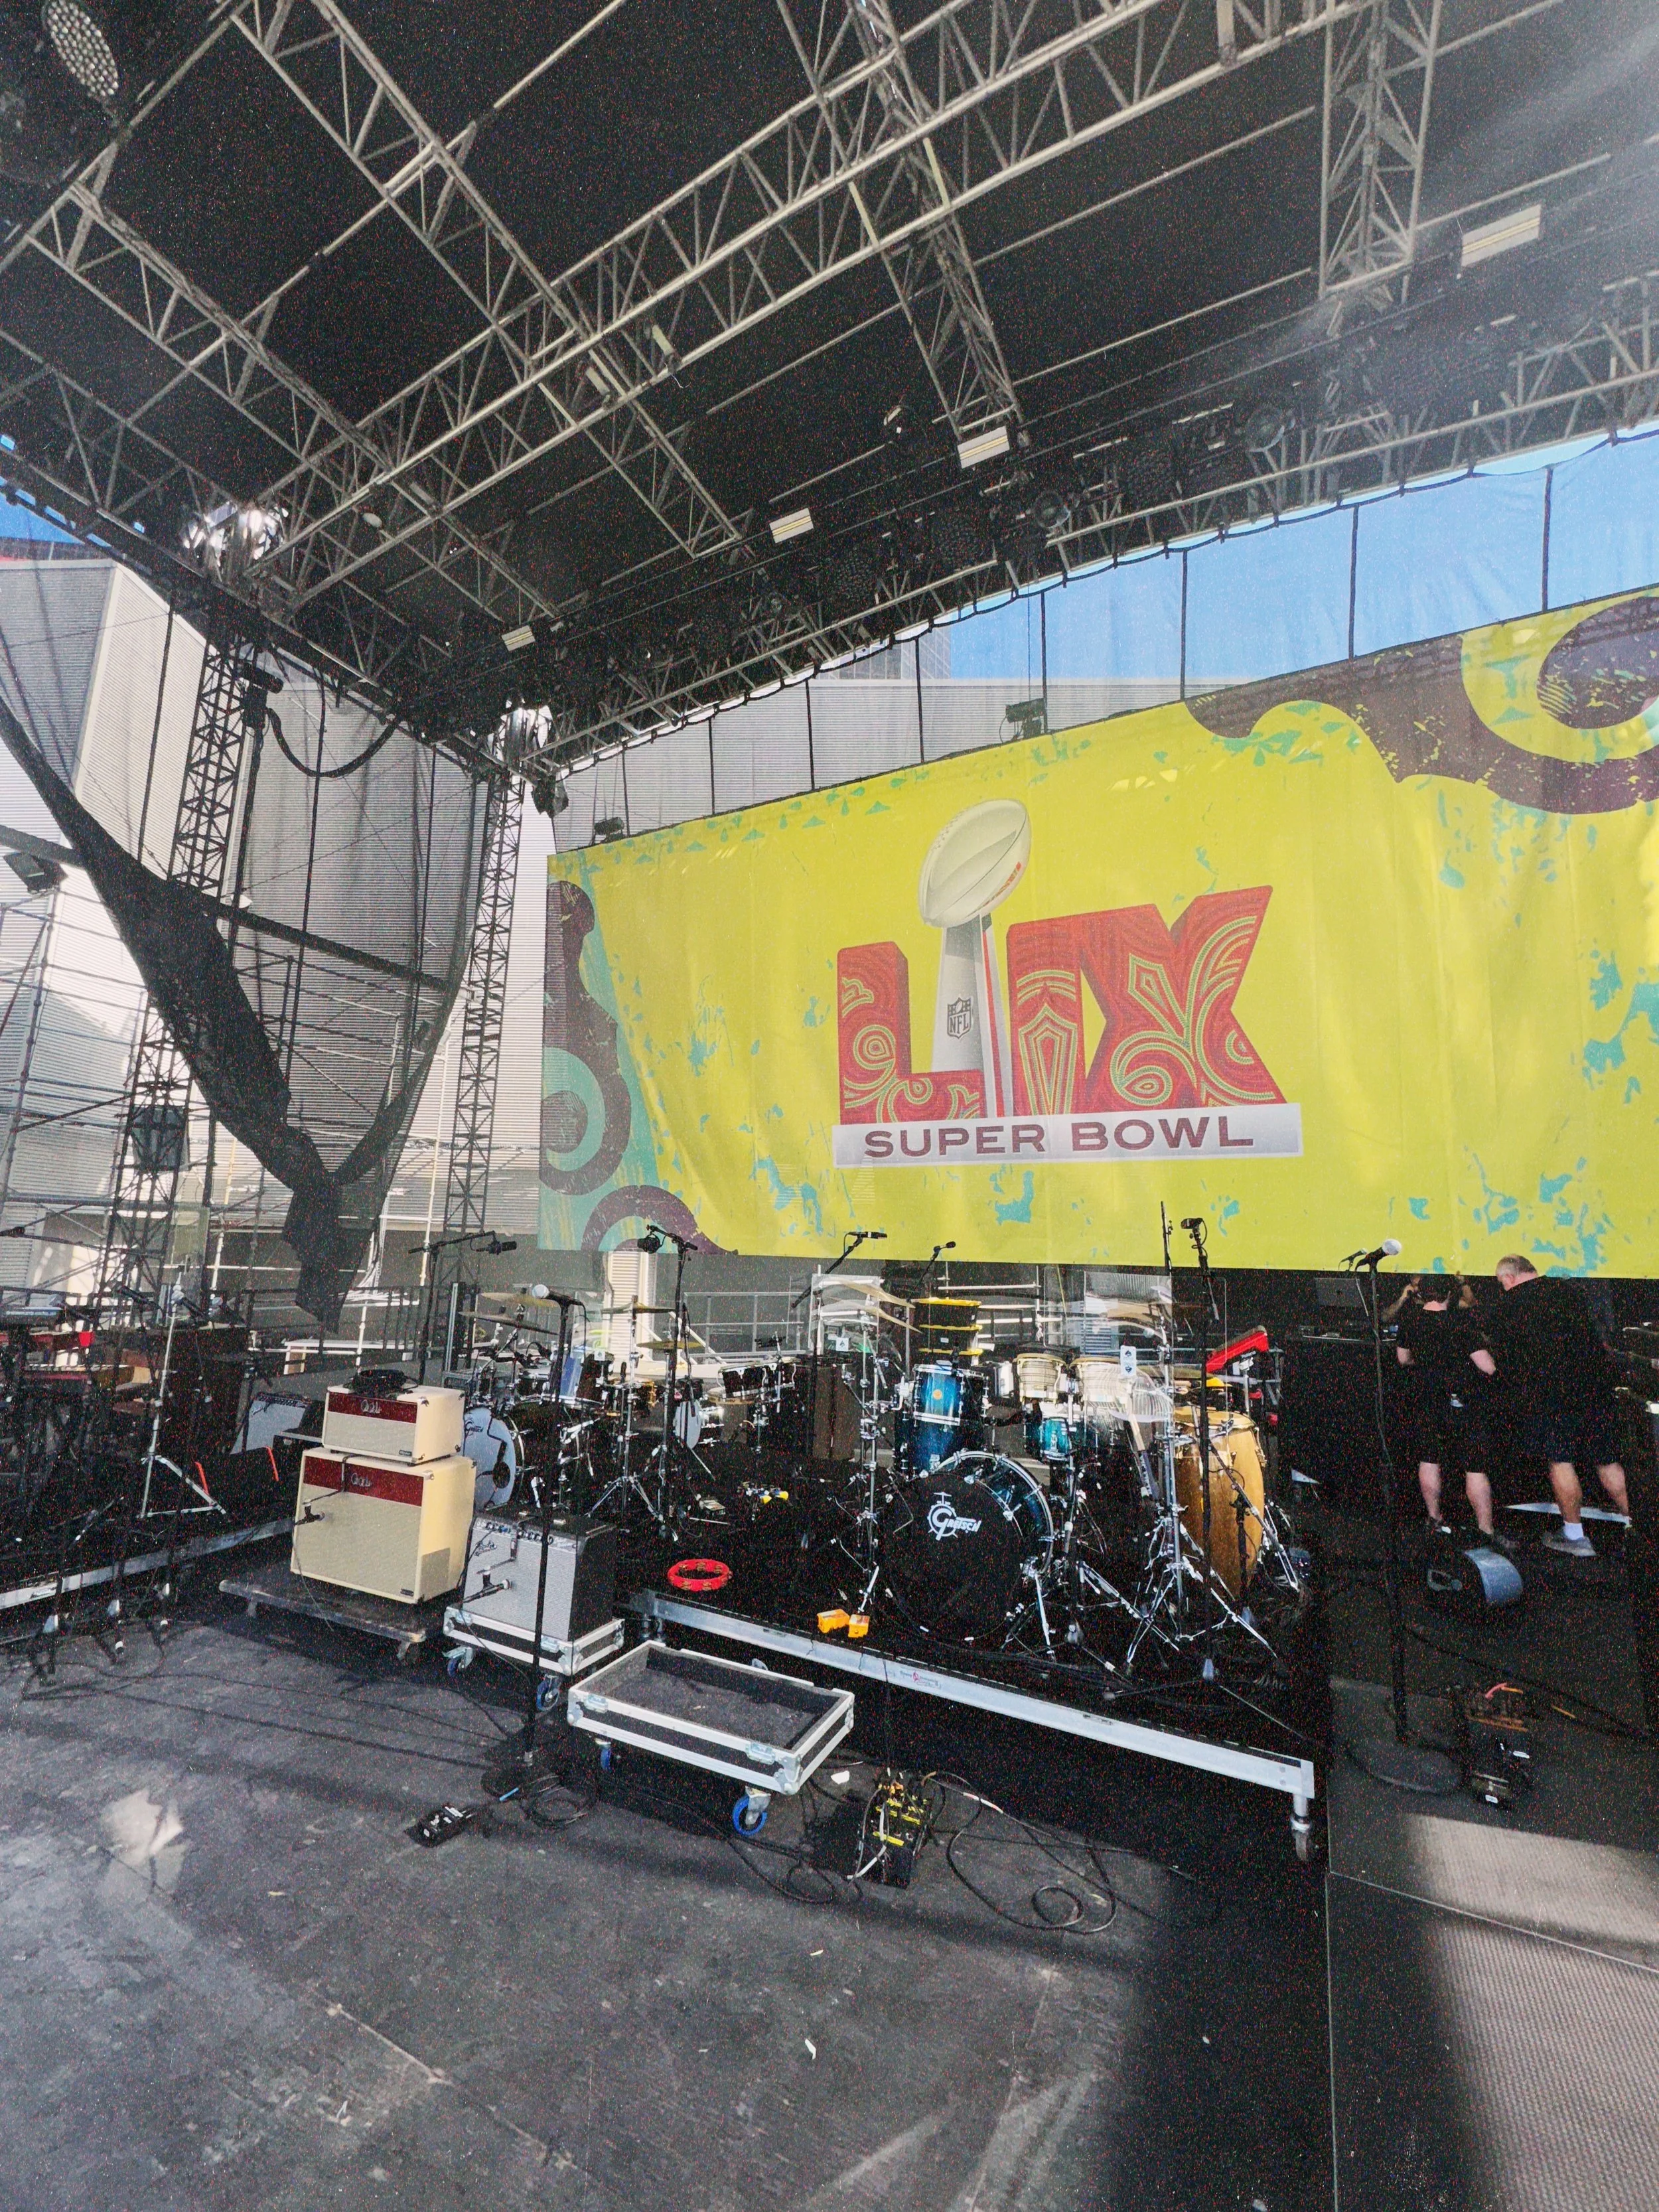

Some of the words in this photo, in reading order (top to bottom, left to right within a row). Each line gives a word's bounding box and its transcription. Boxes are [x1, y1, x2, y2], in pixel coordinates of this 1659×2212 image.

[949, 1013, 969, 1034] NFL
[865, 1124, 1046, 1157] SUPER
[1072, 1116, 1254, 1153] BOWL
